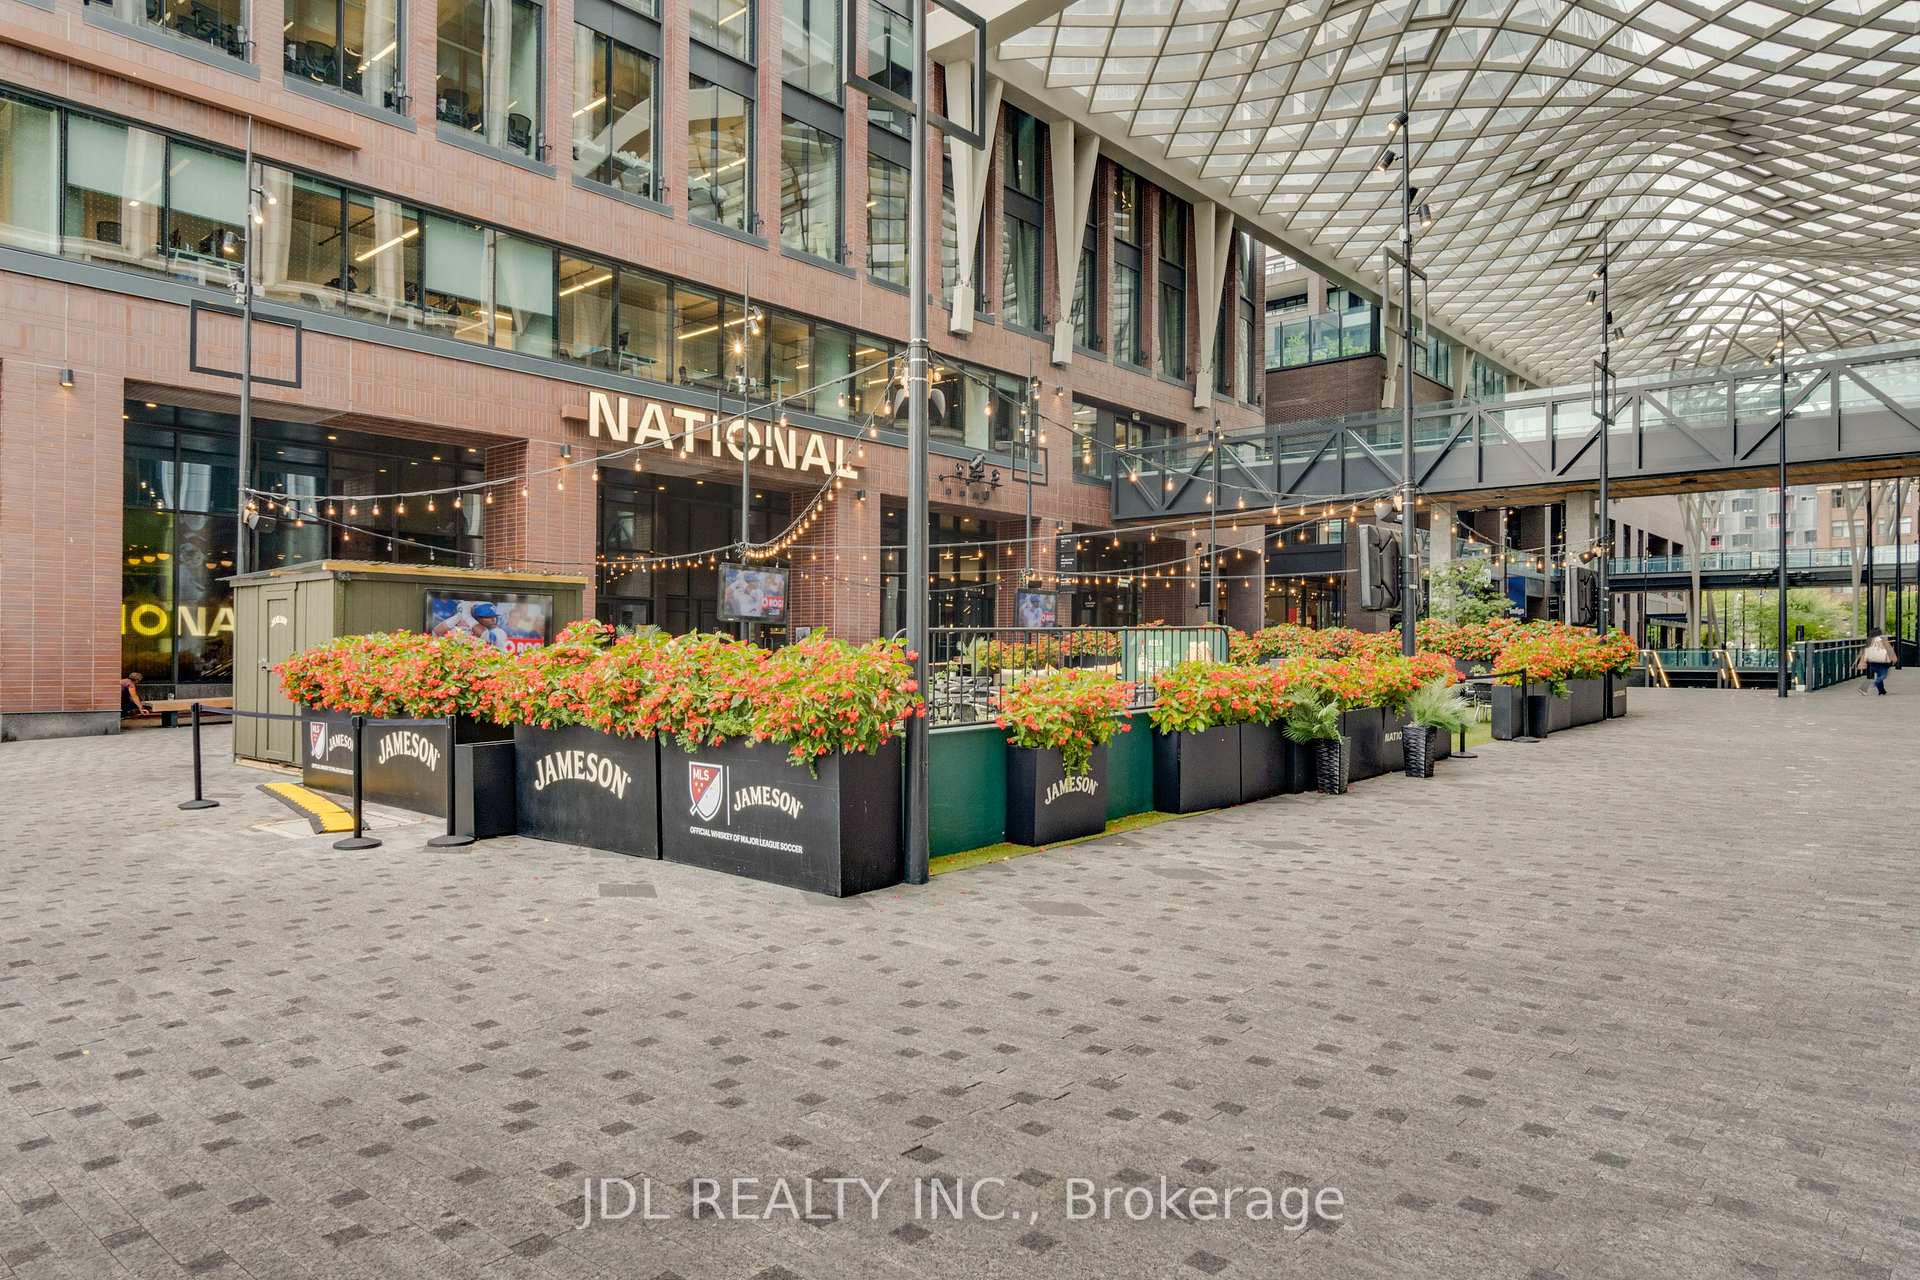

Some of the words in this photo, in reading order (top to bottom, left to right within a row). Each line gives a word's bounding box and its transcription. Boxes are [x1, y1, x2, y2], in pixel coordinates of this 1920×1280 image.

[589, 391, 859, 479] NATIONAL
[379, 731, 440, 772] JAMESON
[534, 750, 632, 799] JAMESON
[693, 767, 709, 781] MLS
[1045, 776, 1098, 805] JAMESON
[733, 785, 803, 819] JAMESON
[689, 826, 711, 837] OFFICIAL
[711, 829, 733, 840] WHISKEY
[733, 834, 741, 842] OF
[741, 836, 760, 846] MAJOR
[760, 839, 780, 850] LEAGUE
[780, 843, 804, 854] SOCCER
